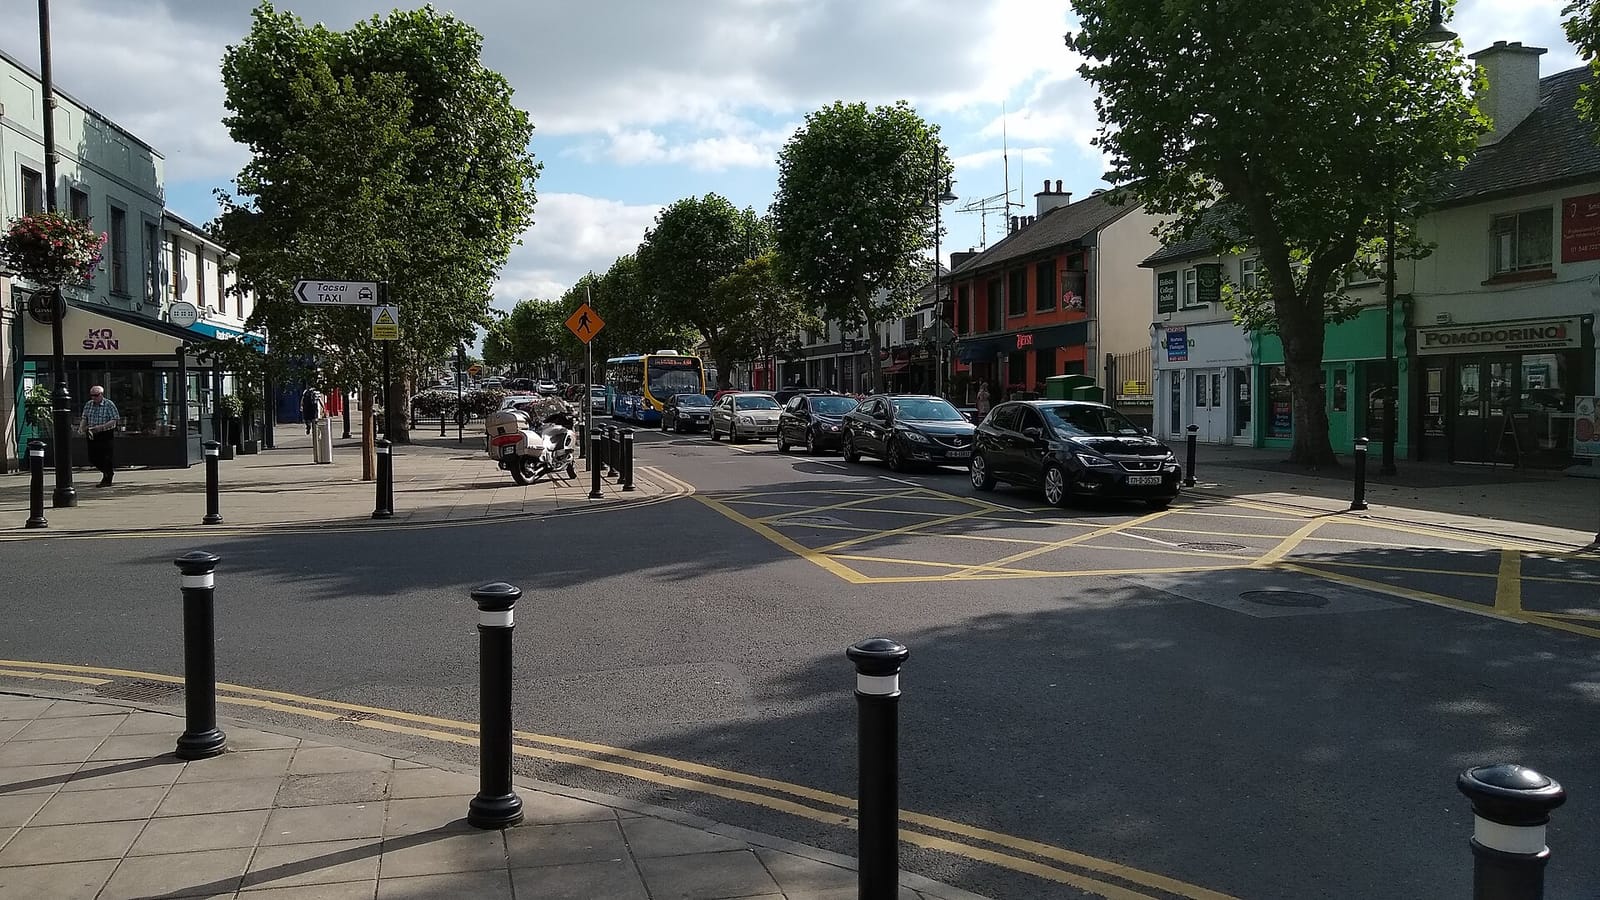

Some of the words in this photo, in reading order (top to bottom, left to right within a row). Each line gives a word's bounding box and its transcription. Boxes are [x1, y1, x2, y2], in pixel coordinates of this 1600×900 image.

[318, 294, 342, 302] TAXI
[88, 328, 113, 339] KO
[82, 339, 119, 350] SAN
